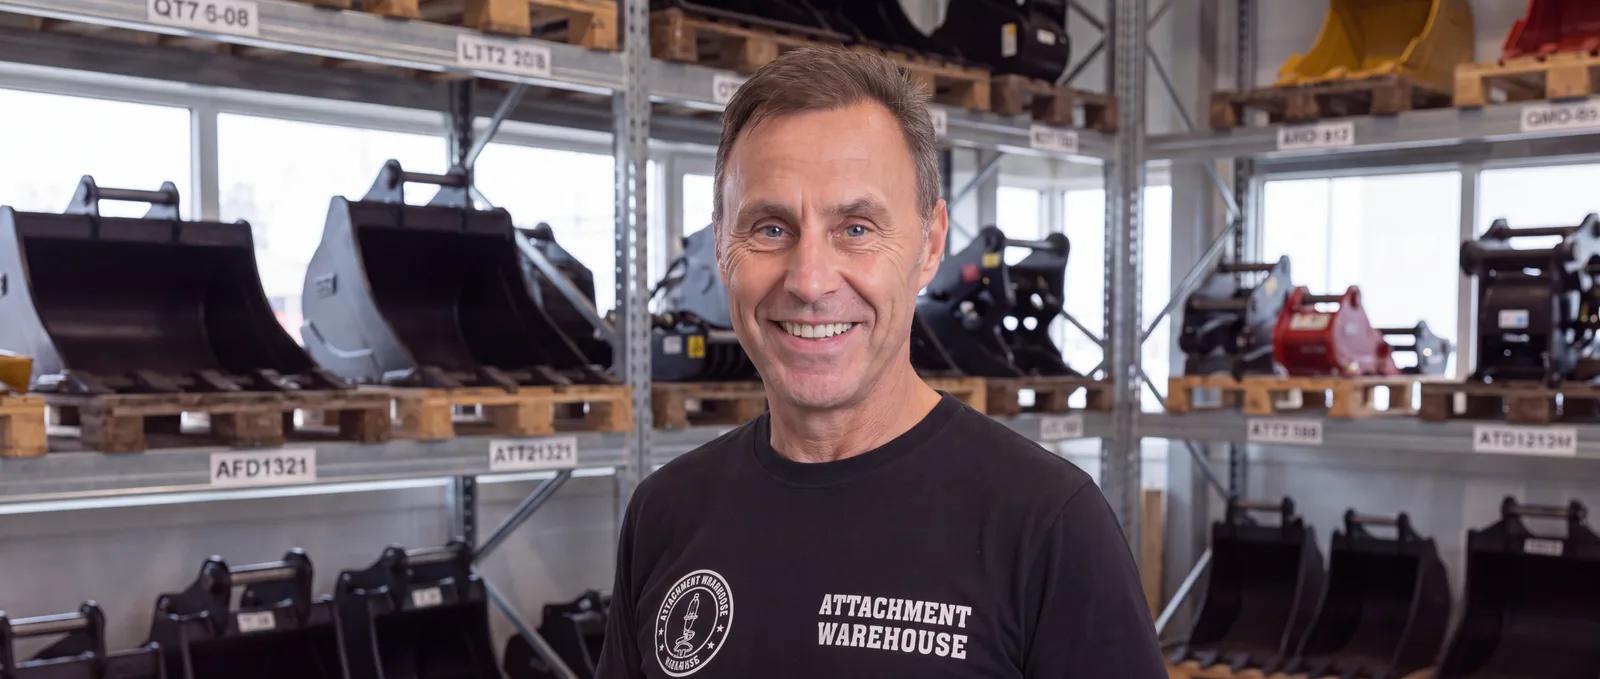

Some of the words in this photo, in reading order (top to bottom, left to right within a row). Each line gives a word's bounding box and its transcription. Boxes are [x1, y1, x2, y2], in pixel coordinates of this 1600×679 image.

[216, 457, 307, 479] AFD1321
[818, 593, 972, 629] ATTACHMENT
[817, 621, 969, 660] WAREHOUSE
